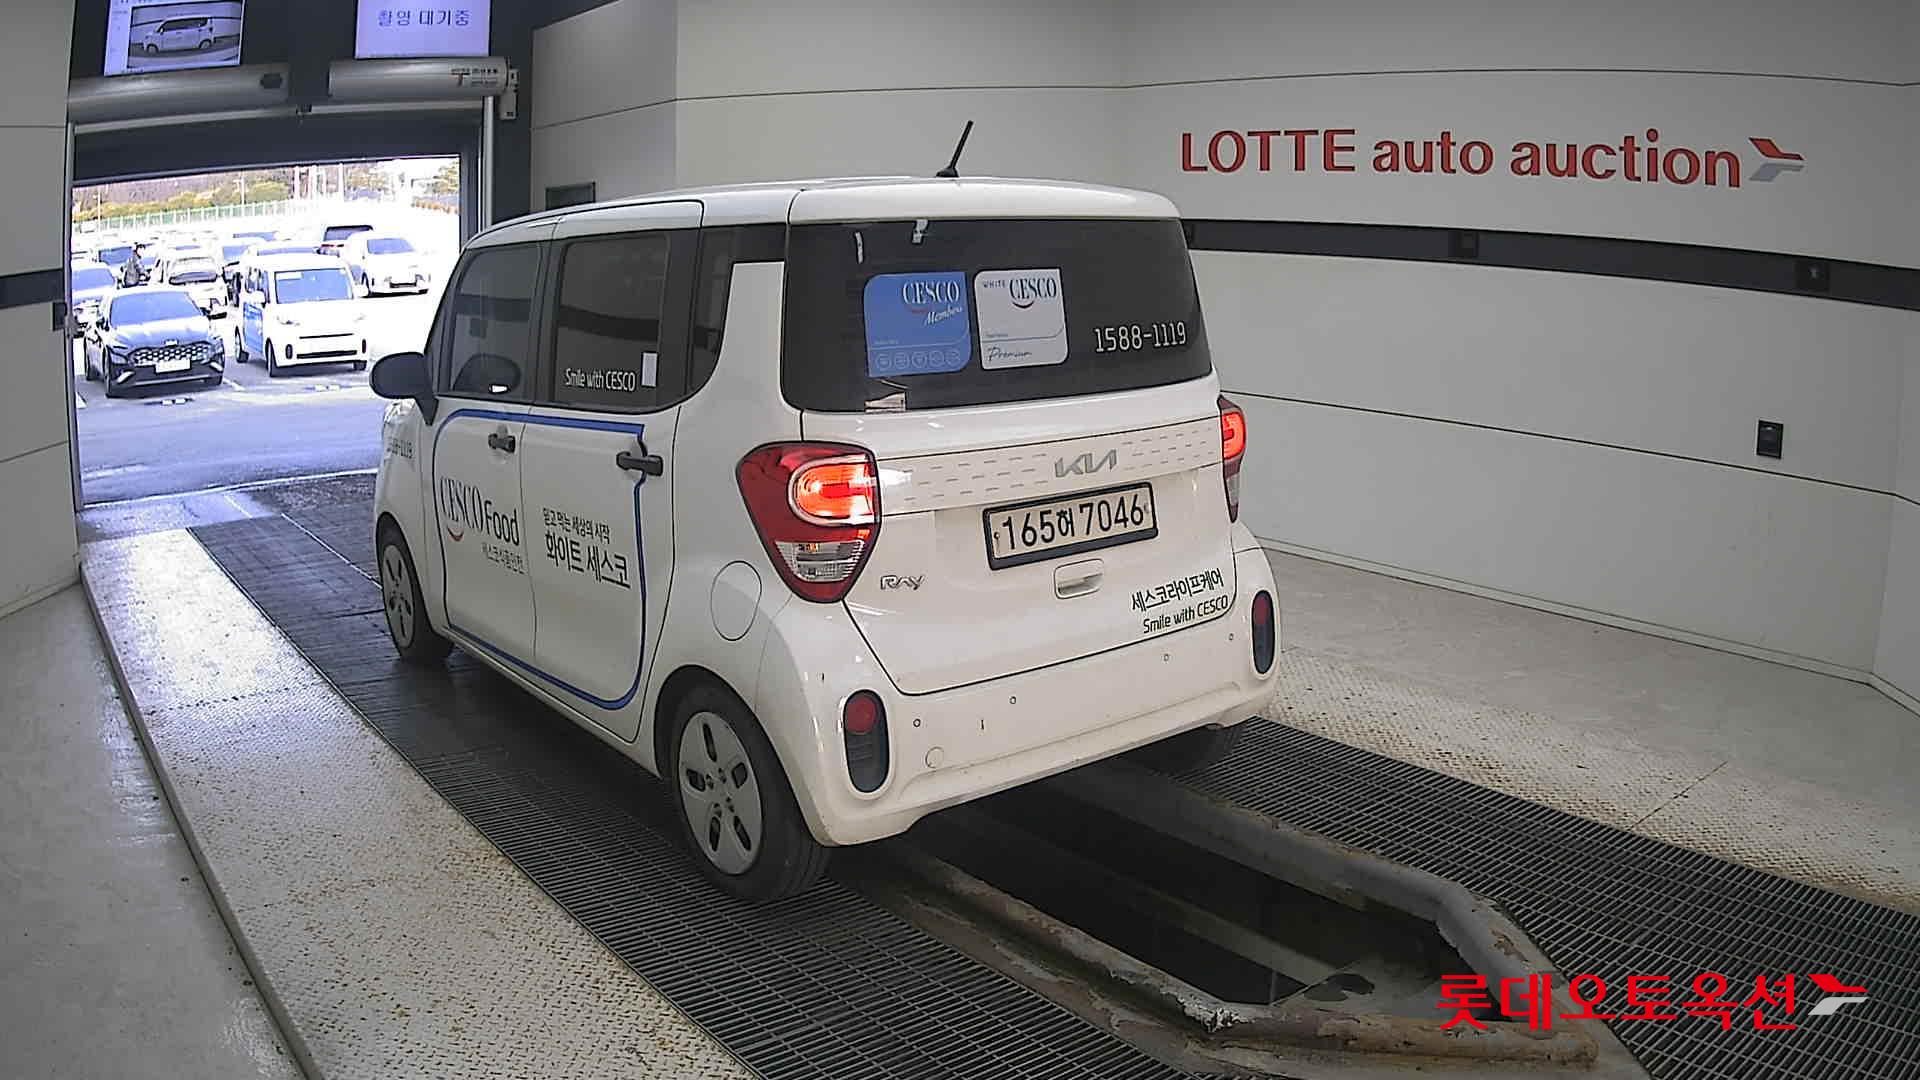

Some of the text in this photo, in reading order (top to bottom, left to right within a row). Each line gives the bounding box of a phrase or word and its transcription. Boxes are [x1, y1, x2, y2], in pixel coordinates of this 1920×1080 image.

[418, 9, 470, 26] 대기중
[1181, 128, 1741, 188] LOTTE auto auction
[902, 281, 960, 304] CESCO
[1009, 278, 1057, 300] CESCO
[1094, 321, 1187, 353] 1588-1119
[566, 367, 636, 392] Smile with CESCO
[440, 475, 520, 547] CESCO Food
[573, 516, 594, 540] 세상의
[595, 522, 610, 545] 시작
[545, 529, 631, 589] 화이트 세스코
[880, 574, 924, 591] RAY
[1131, 567, 1224, 612] 세스코라이프케어
[1143, 594, 1229, 634] Smile with CESCO
